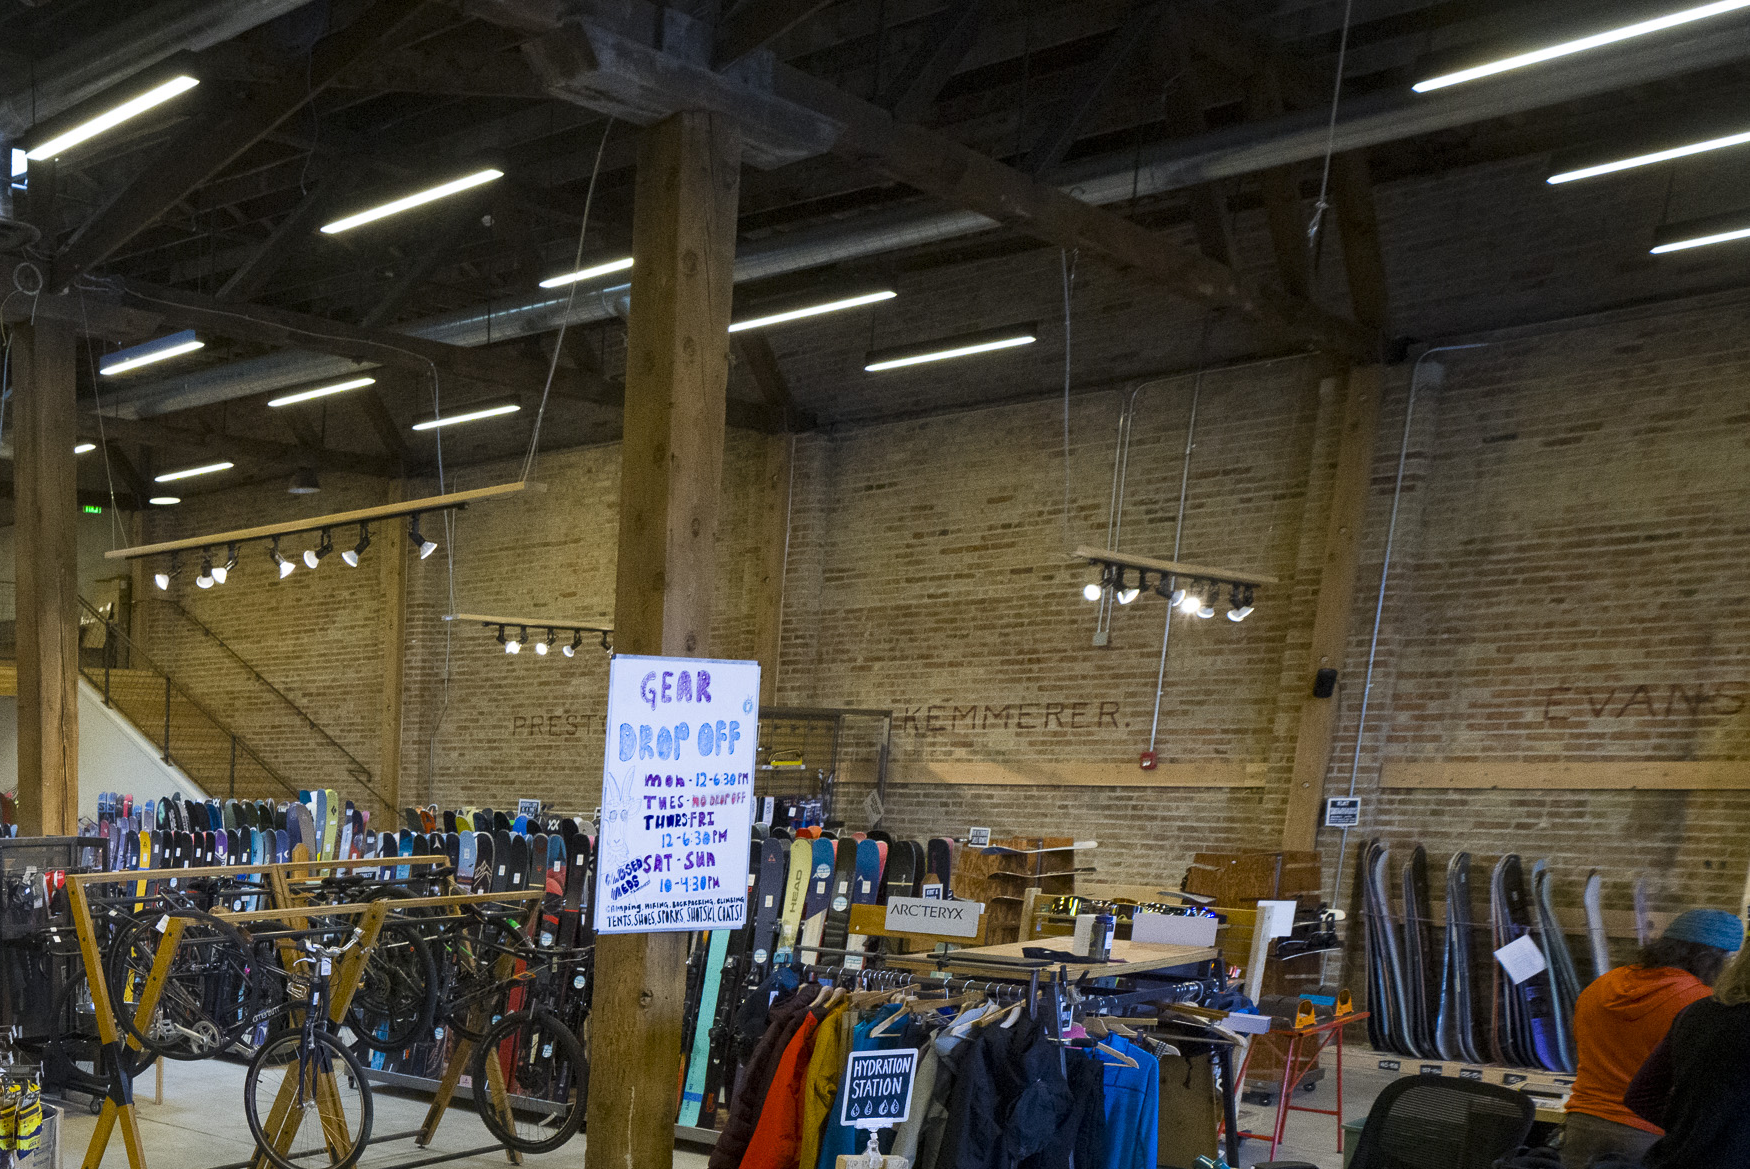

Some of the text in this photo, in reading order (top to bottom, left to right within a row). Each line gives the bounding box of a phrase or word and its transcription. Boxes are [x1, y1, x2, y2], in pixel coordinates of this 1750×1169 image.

[640, 670, 711, 711] GEAR
[1544, 683, 1746, 720] EVANS
[512, 714, 607, 736] PREST
[619, 720, 740, 761] DROP OFF
[692, 795, 706, 808] NO
[710, 793, 729, 806] DROP
[732, 791, 746, 804] OFF
[643, 854, 672, 873] SAT
[788, 868, 803, 912] HEAD
[717, 904, 742, 921] COATS!
[853, 1056, 911, 1077] HYDRATION
[851, 1078, 902, 1098] STATION
